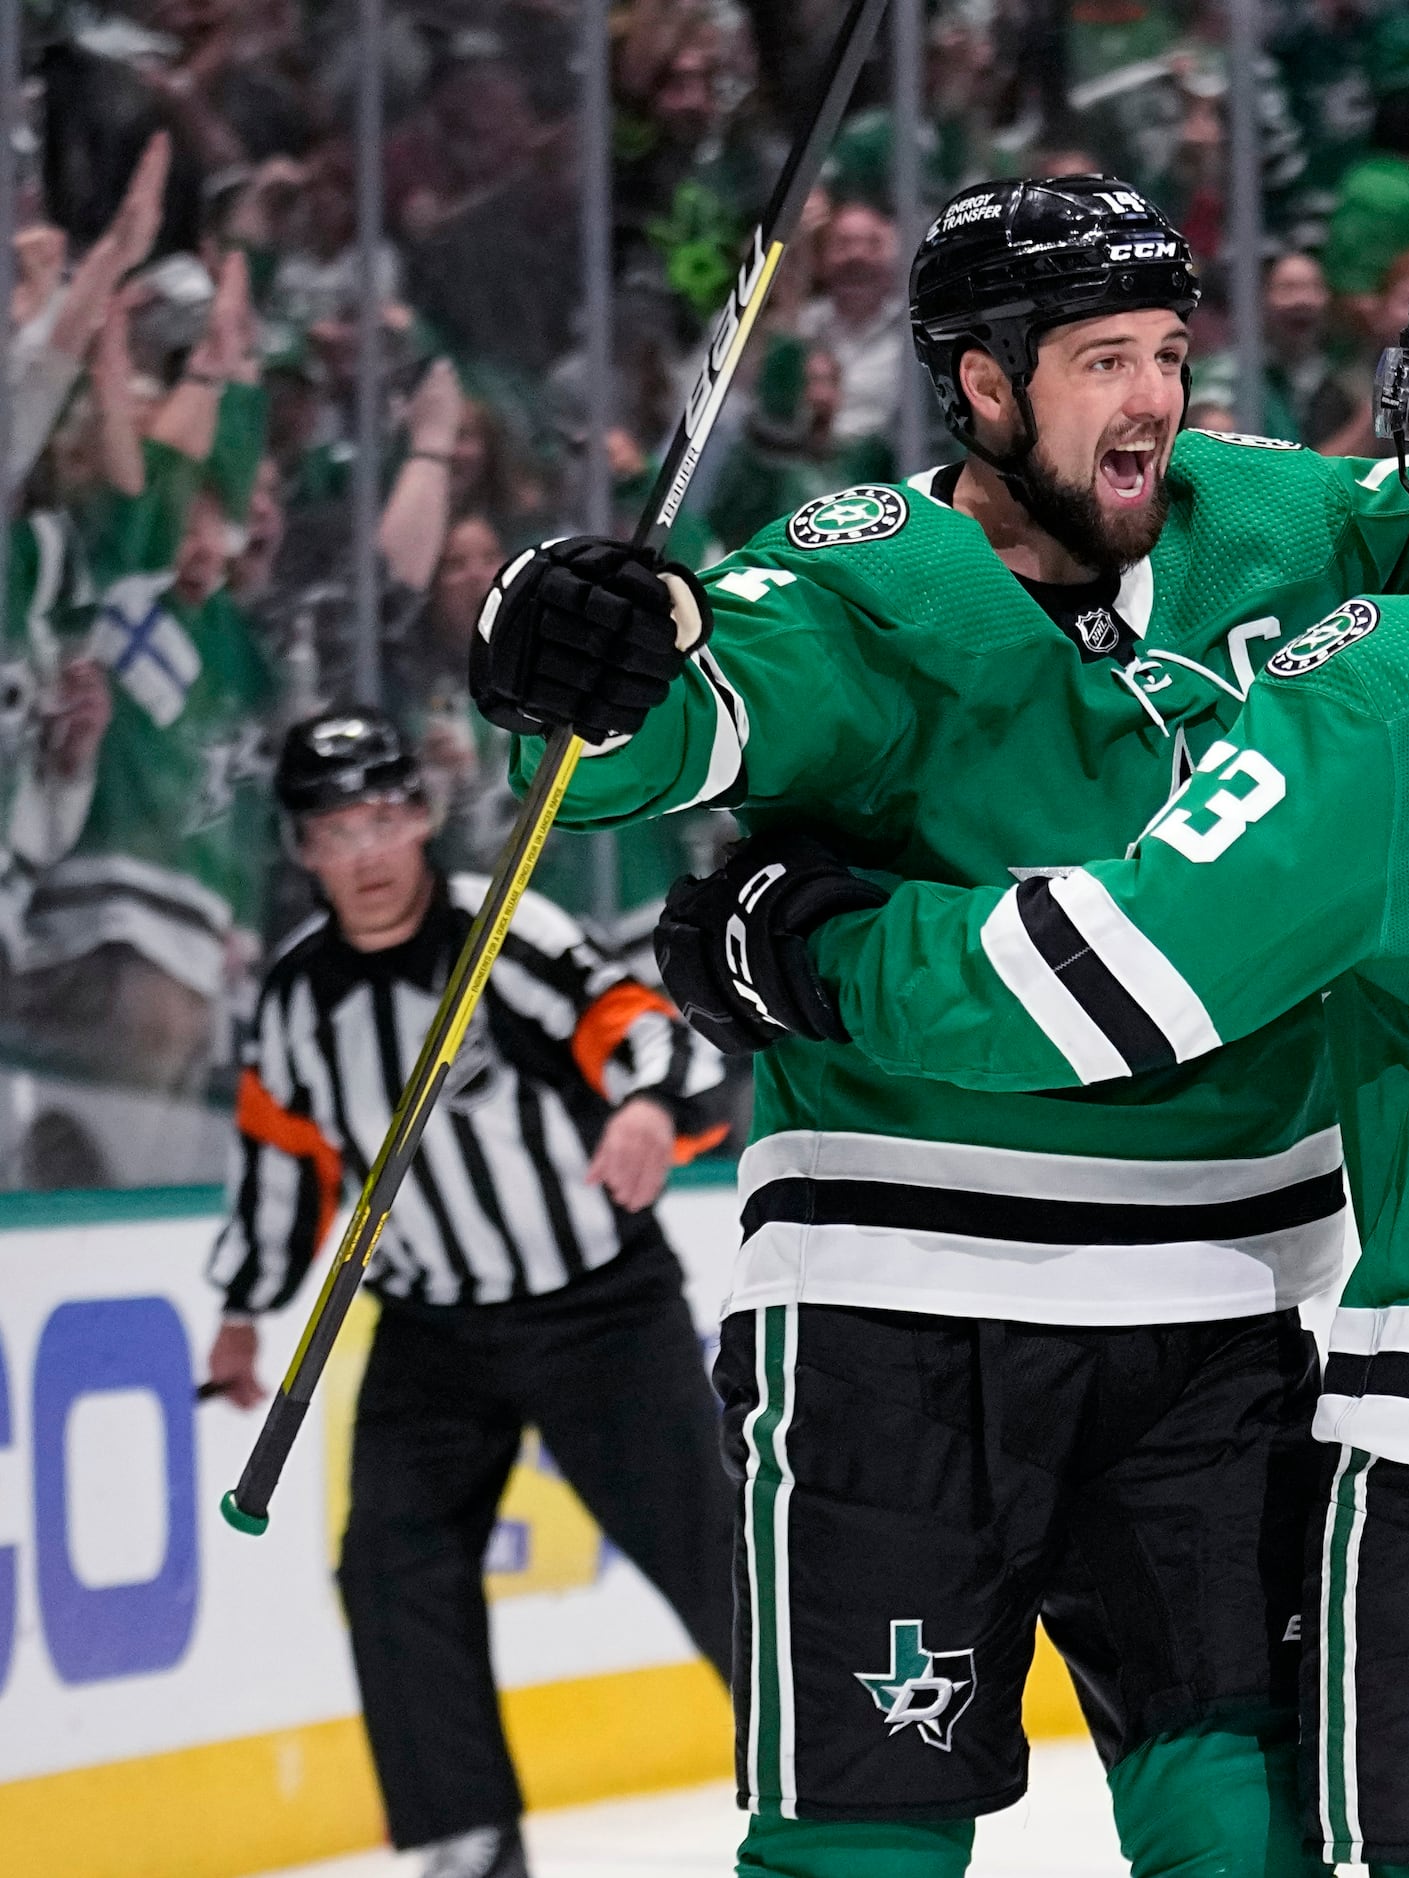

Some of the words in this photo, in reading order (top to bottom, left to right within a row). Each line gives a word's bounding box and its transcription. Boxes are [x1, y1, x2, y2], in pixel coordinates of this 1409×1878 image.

[942, 204, 1003, 232] TRANSFER
[945, 193, 995, 218] ENERGY
[1110, 242, 1177, 261] CCM
